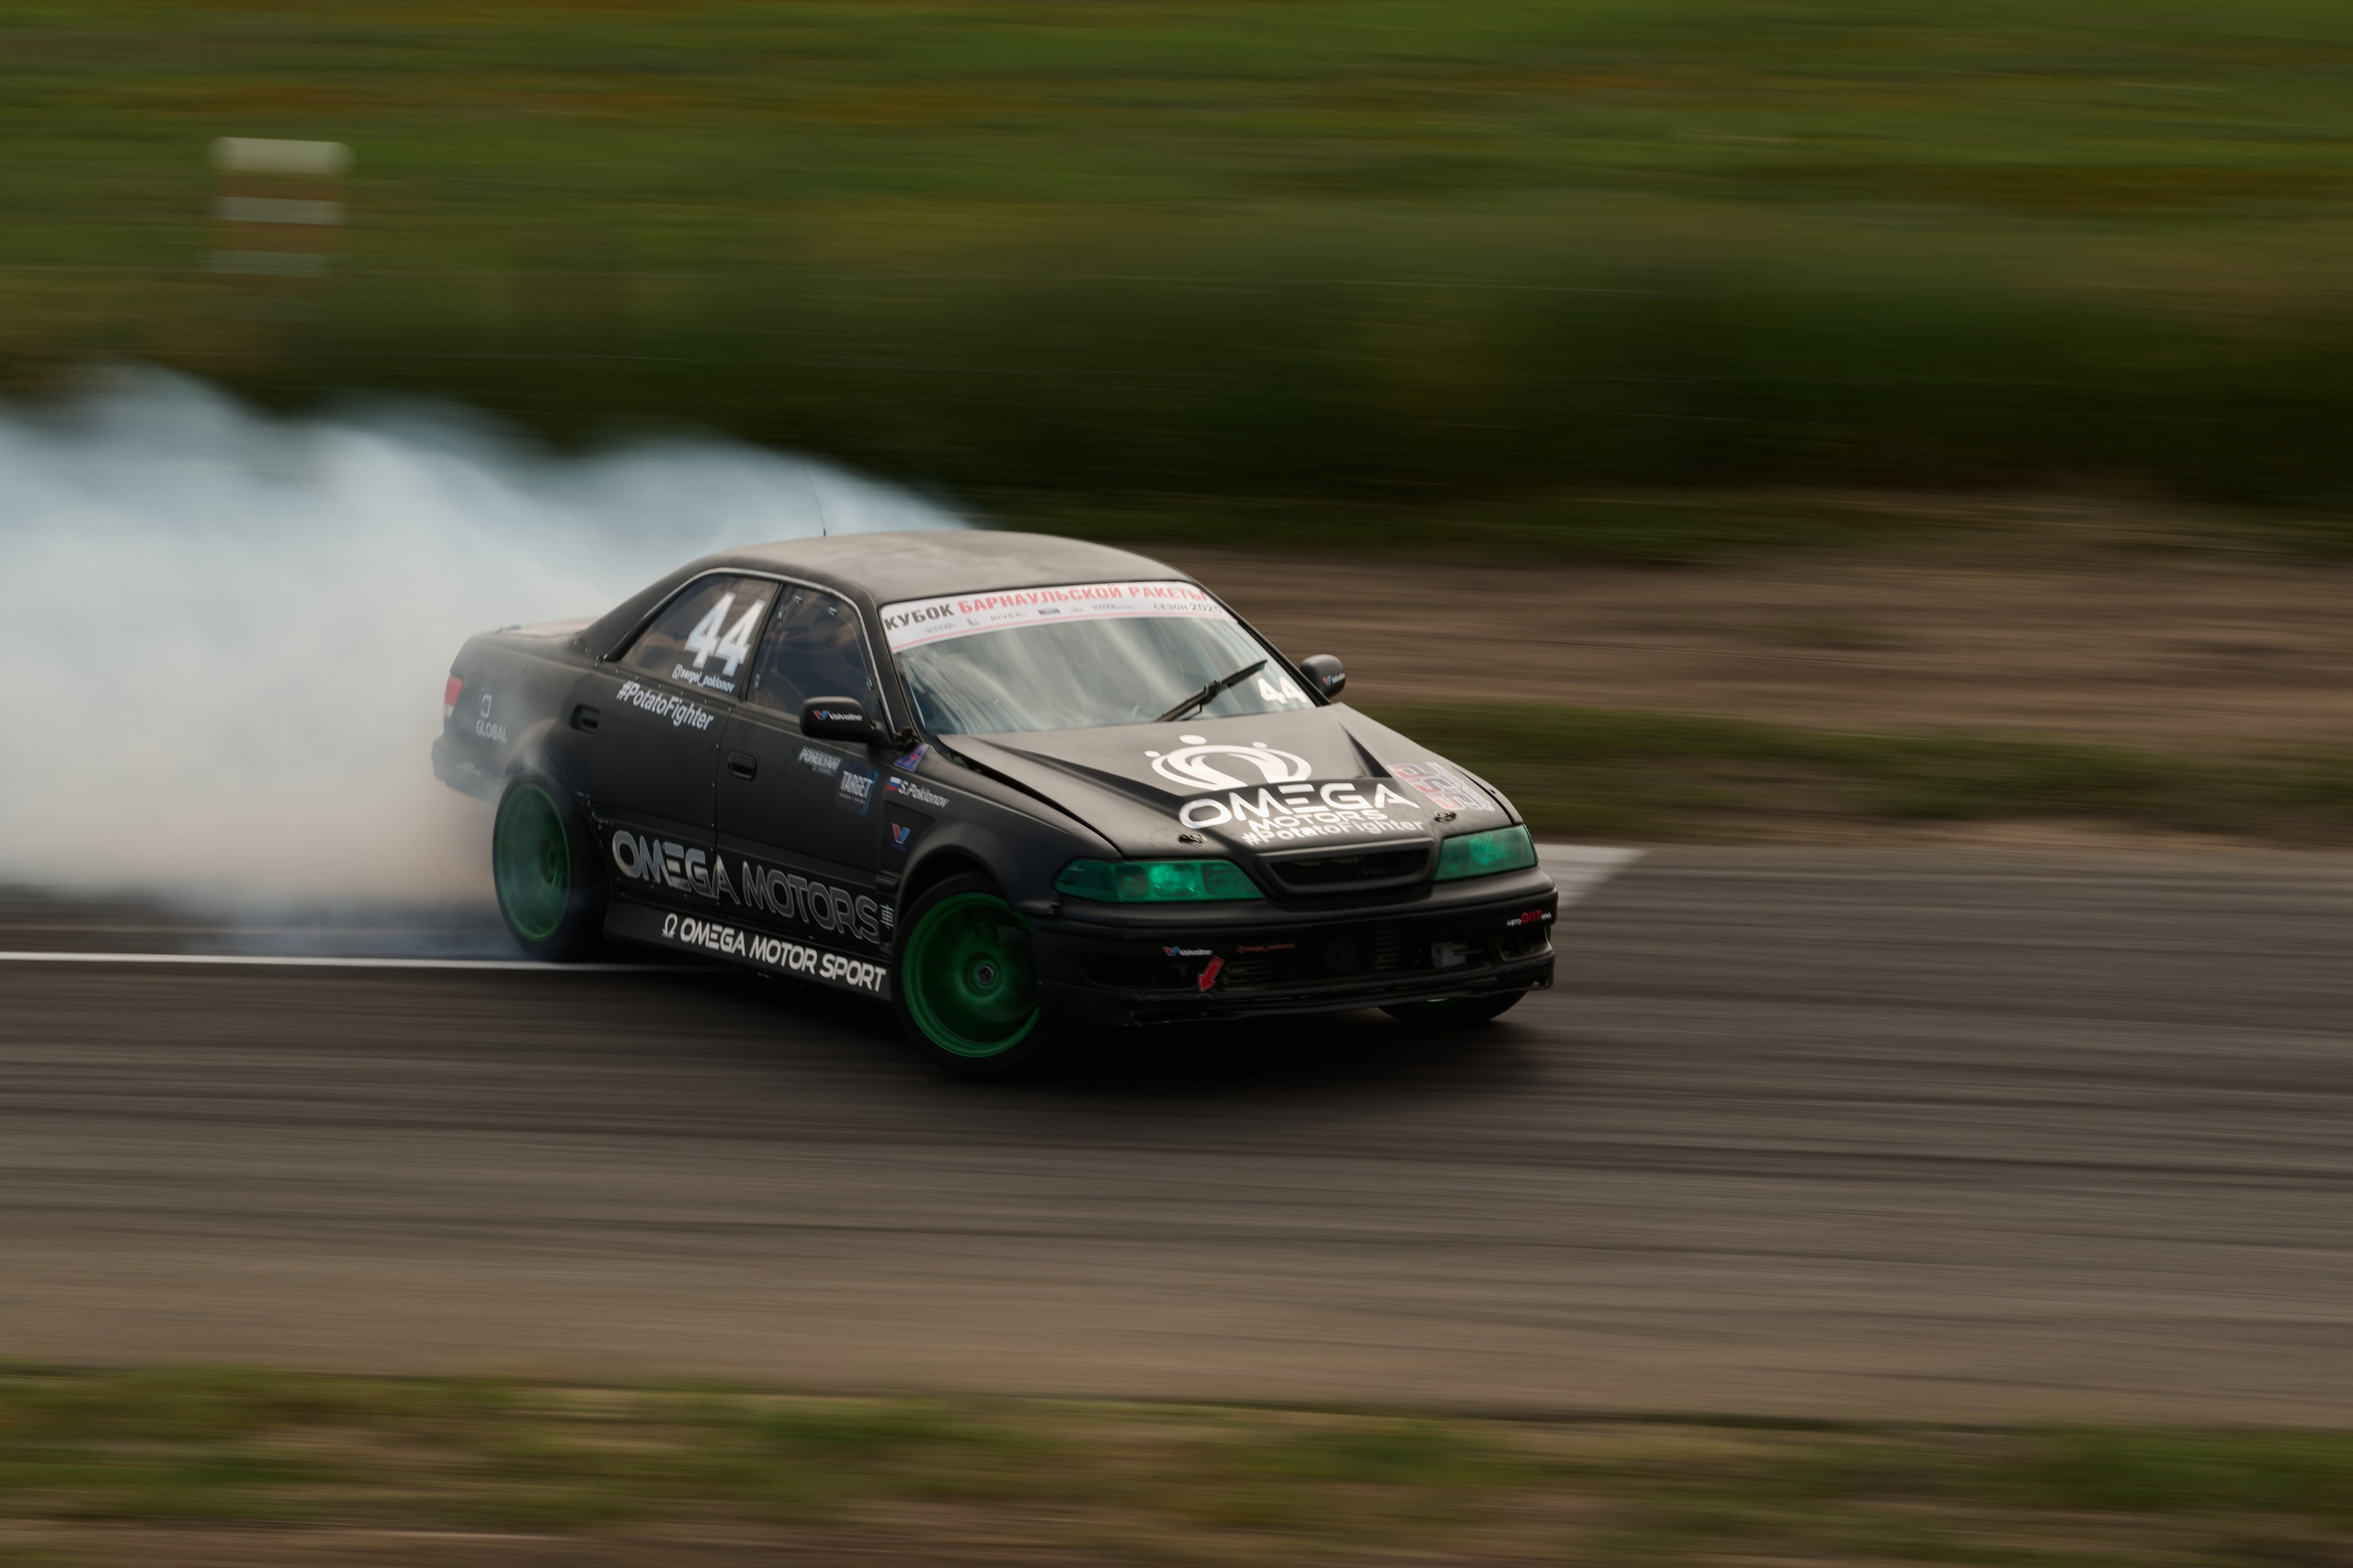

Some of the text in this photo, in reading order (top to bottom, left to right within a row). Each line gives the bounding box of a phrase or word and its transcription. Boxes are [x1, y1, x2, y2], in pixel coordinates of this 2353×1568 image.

[883, 583, 1209, 631] КУБОК БАРНАУЛЬСКОЙ РАКЕТЫ
[684, 591, 767, 677] 44
[616, 679, 715, 731] #PotatoFighter
[1256, 676, 1308, 704] 44
[476, 719, 507, 744] GLOBAL
[839, 770, 874, 799] TARGET
[897, 780, 950, 808] S.Poklonov
[1178, 782, 1421, 829] OMEGA
[1247, 809, 1389, 833] MOTORS
[612, 830, 881, 945] OMEGA MOTORS
[679, 917, 745, 957] OMEGA
[749, 934, 818, 974] MOTOR
[818, 953, 886, 992] SPORT
